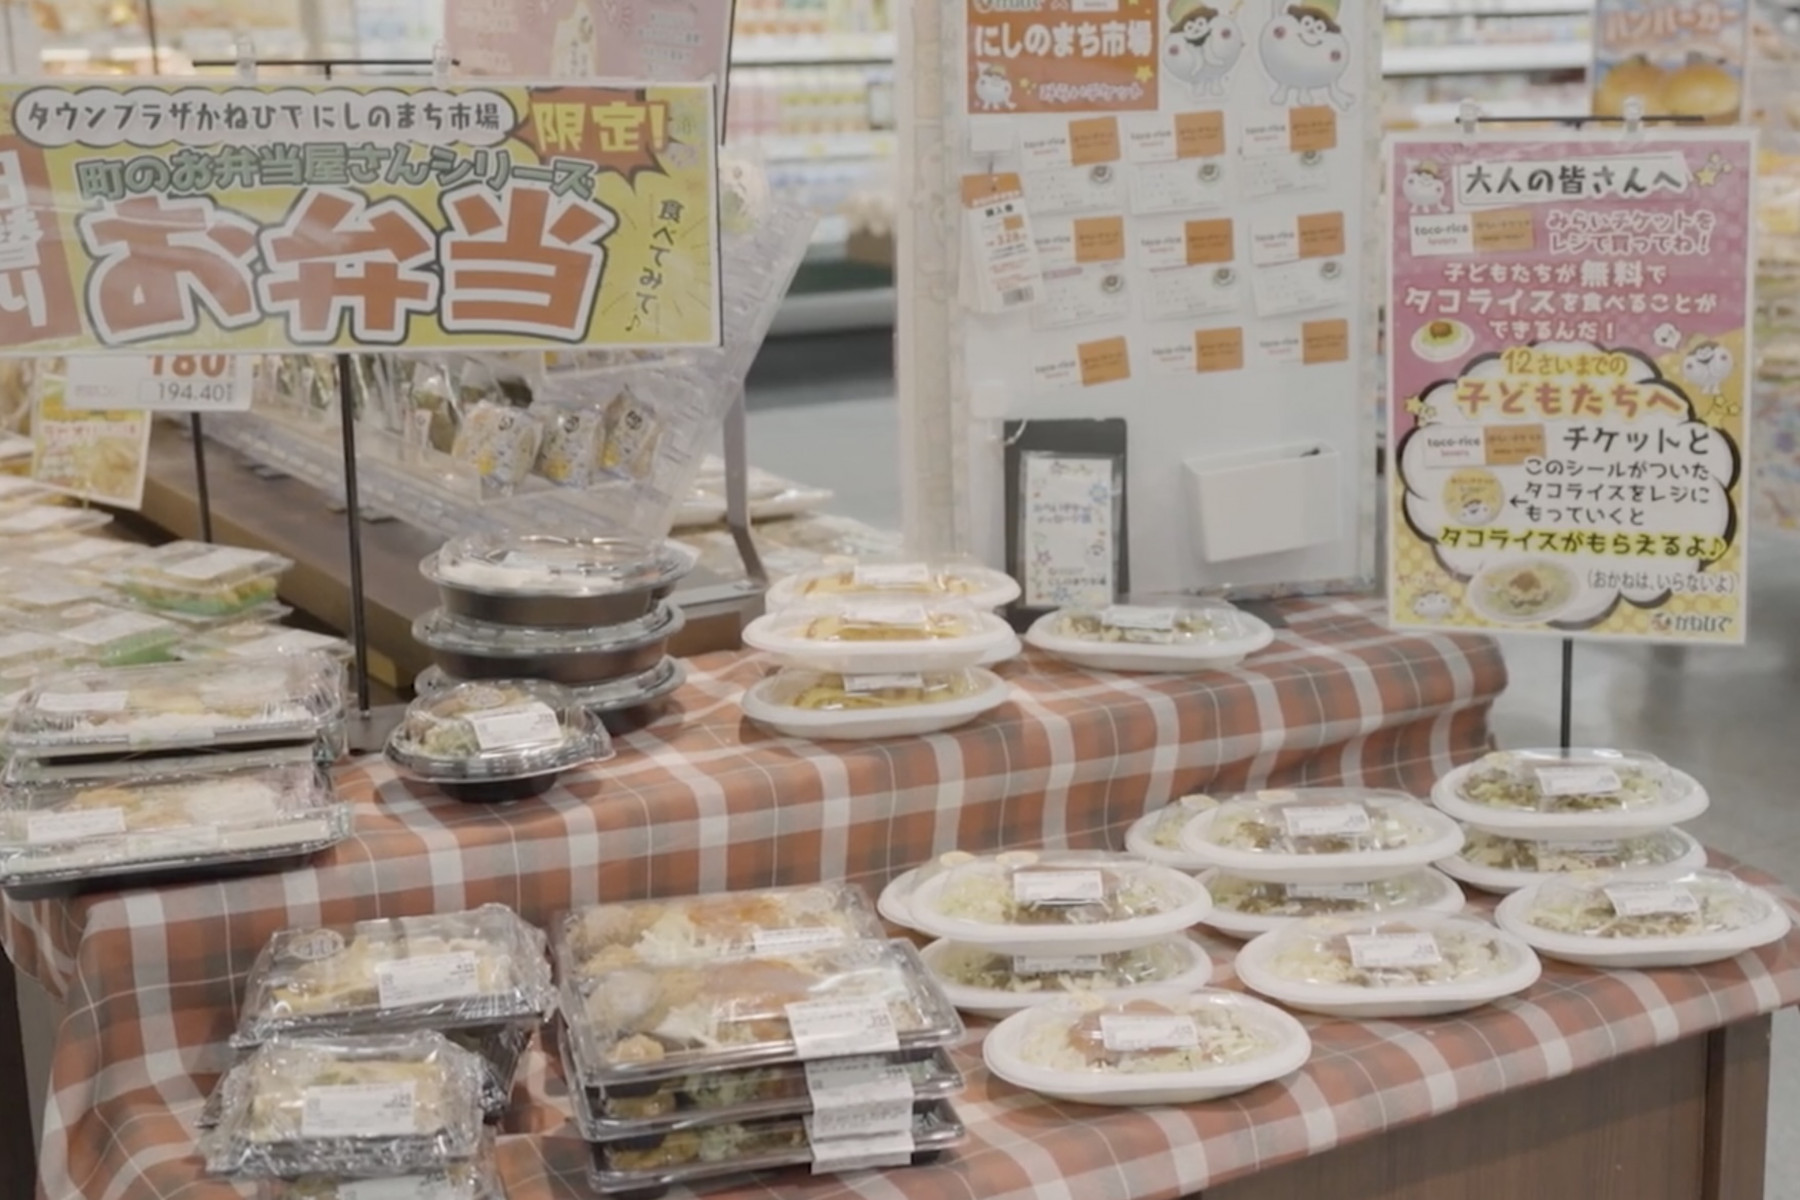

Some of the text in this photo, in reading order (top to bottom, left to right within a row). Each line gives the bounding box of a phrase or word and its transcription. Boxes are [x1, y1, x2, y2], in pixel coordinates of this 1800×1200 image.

[975, 20, 1152, 58] にしのまち市場
[76, 142, 597, 200] 町のお弁当屋さんシリーズ
[1465, 164, 1682, 195] 大人の皆さんへ
[1547, 210, 1717, 233] みらいチケットを
[89, 186, 606, 335] お弁当
[1444, 261, 1667, 288] 子どもたちが無料で
[1405, 288, 1717, 315] タコライスを食べることが
[1504, 351, 1628, 375] 12さいまでの
[158, 383, 225, 402] 194.40
[1458, 382, 1682, 418] 子どもたちへ
[1563, 427, 1710, 454] チケットと
[1525, 460, 1710, 480] このシールがついた
[1525, 482, 1710, 503] タコライスをレジに
[1526, 506, 1645, 525] もっていくと
